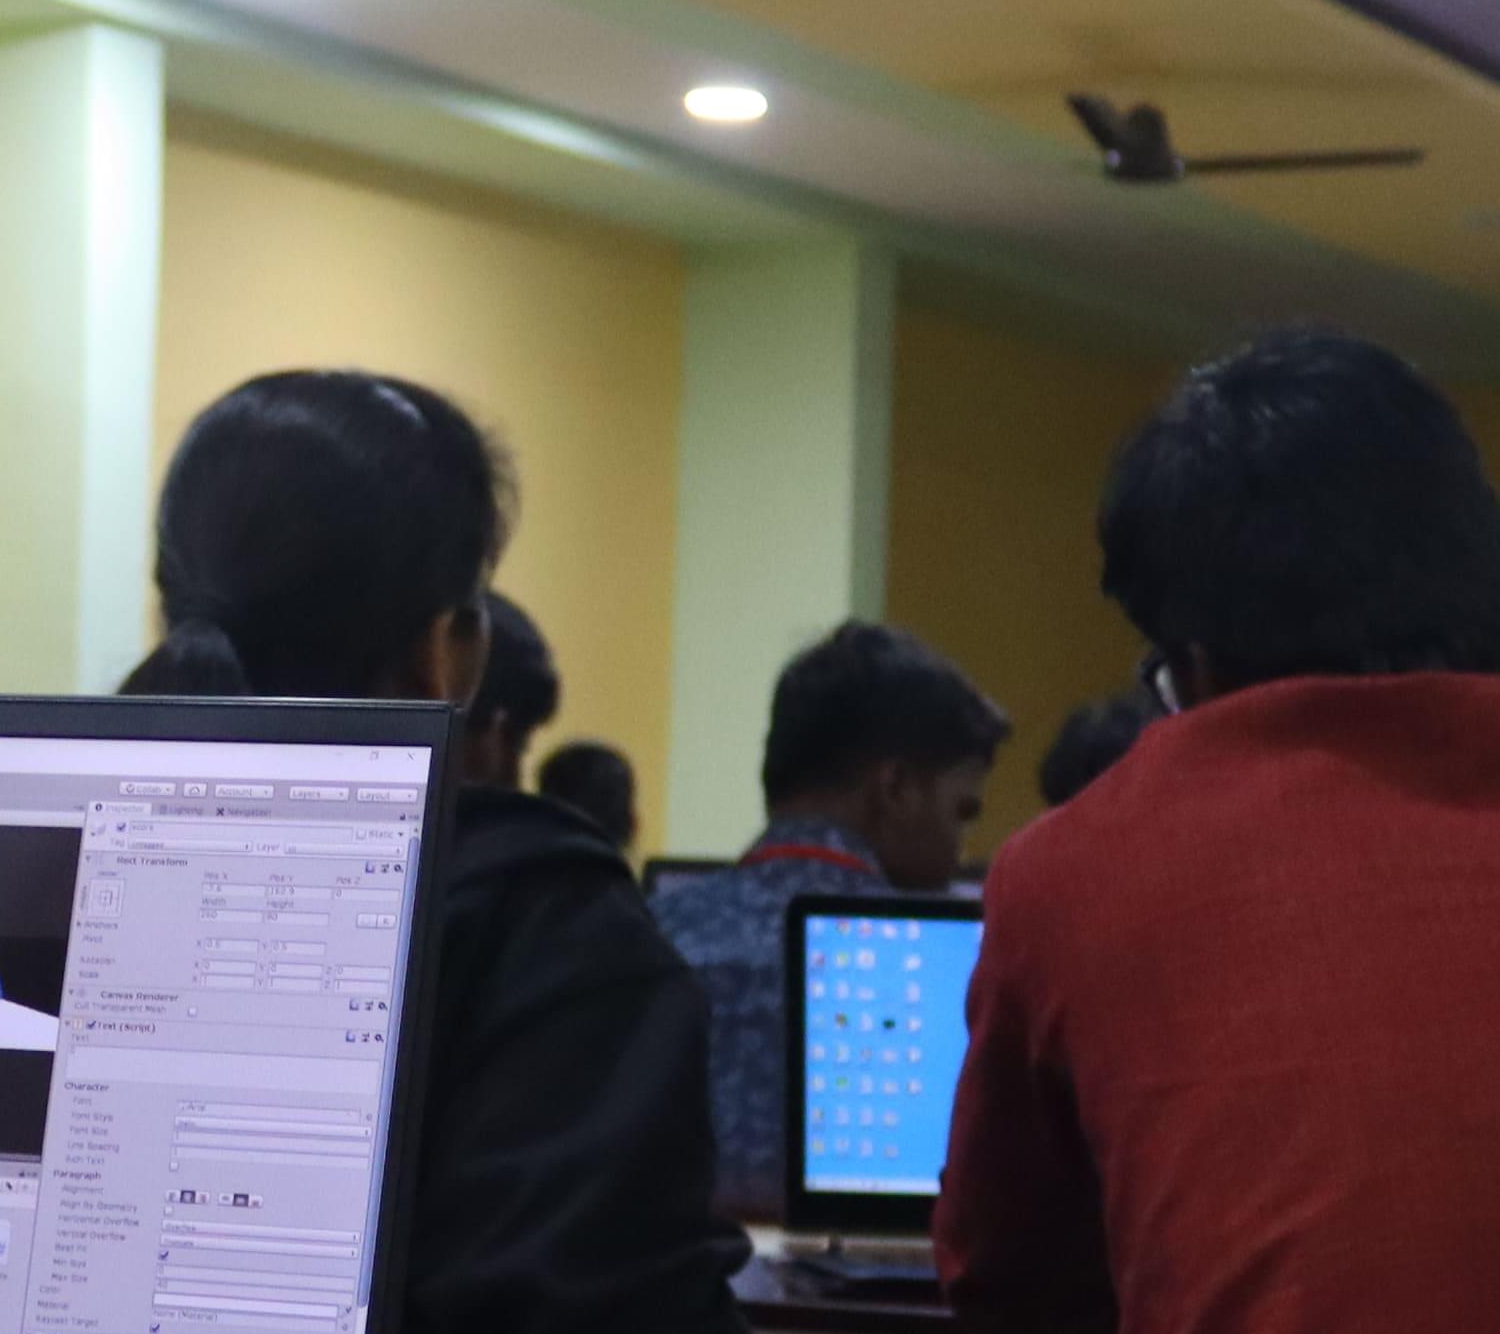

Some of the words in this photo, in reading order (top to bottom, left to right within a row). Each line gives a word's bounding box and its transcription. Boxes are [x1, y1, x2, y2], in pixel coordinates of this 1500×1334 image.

[217, 786, 253, 798] Account
[292, 789, 322, 801] Layers
[359, 791, 391, 802] Layout
[227, 807, 272, 818] Navigation
[256, 843, 280, 854] Layer
[117, 856, 137, 866] Rect
[140, 857, 189, 867] Transform
[202, 897, 227, 906] Width
[266, 899, 295, 910] Height
[83, 920, 119, 930] Anchors
[100, 990, 134, 1000] Canvas
[135, 992, 179, 1002] Renderer
[118, 1022, 156, 1034] (Script)
[64, 1082, 110, 1092] Character
[87, 1142, 120, 1153] Spacing
[53, 1169, 102, 1180] Paragraph
[97, 1201, 138, 1213] Geometry
[103, 1216, 140, 1227] Overflow
[89, 1231, 126, 1241] Overflow
